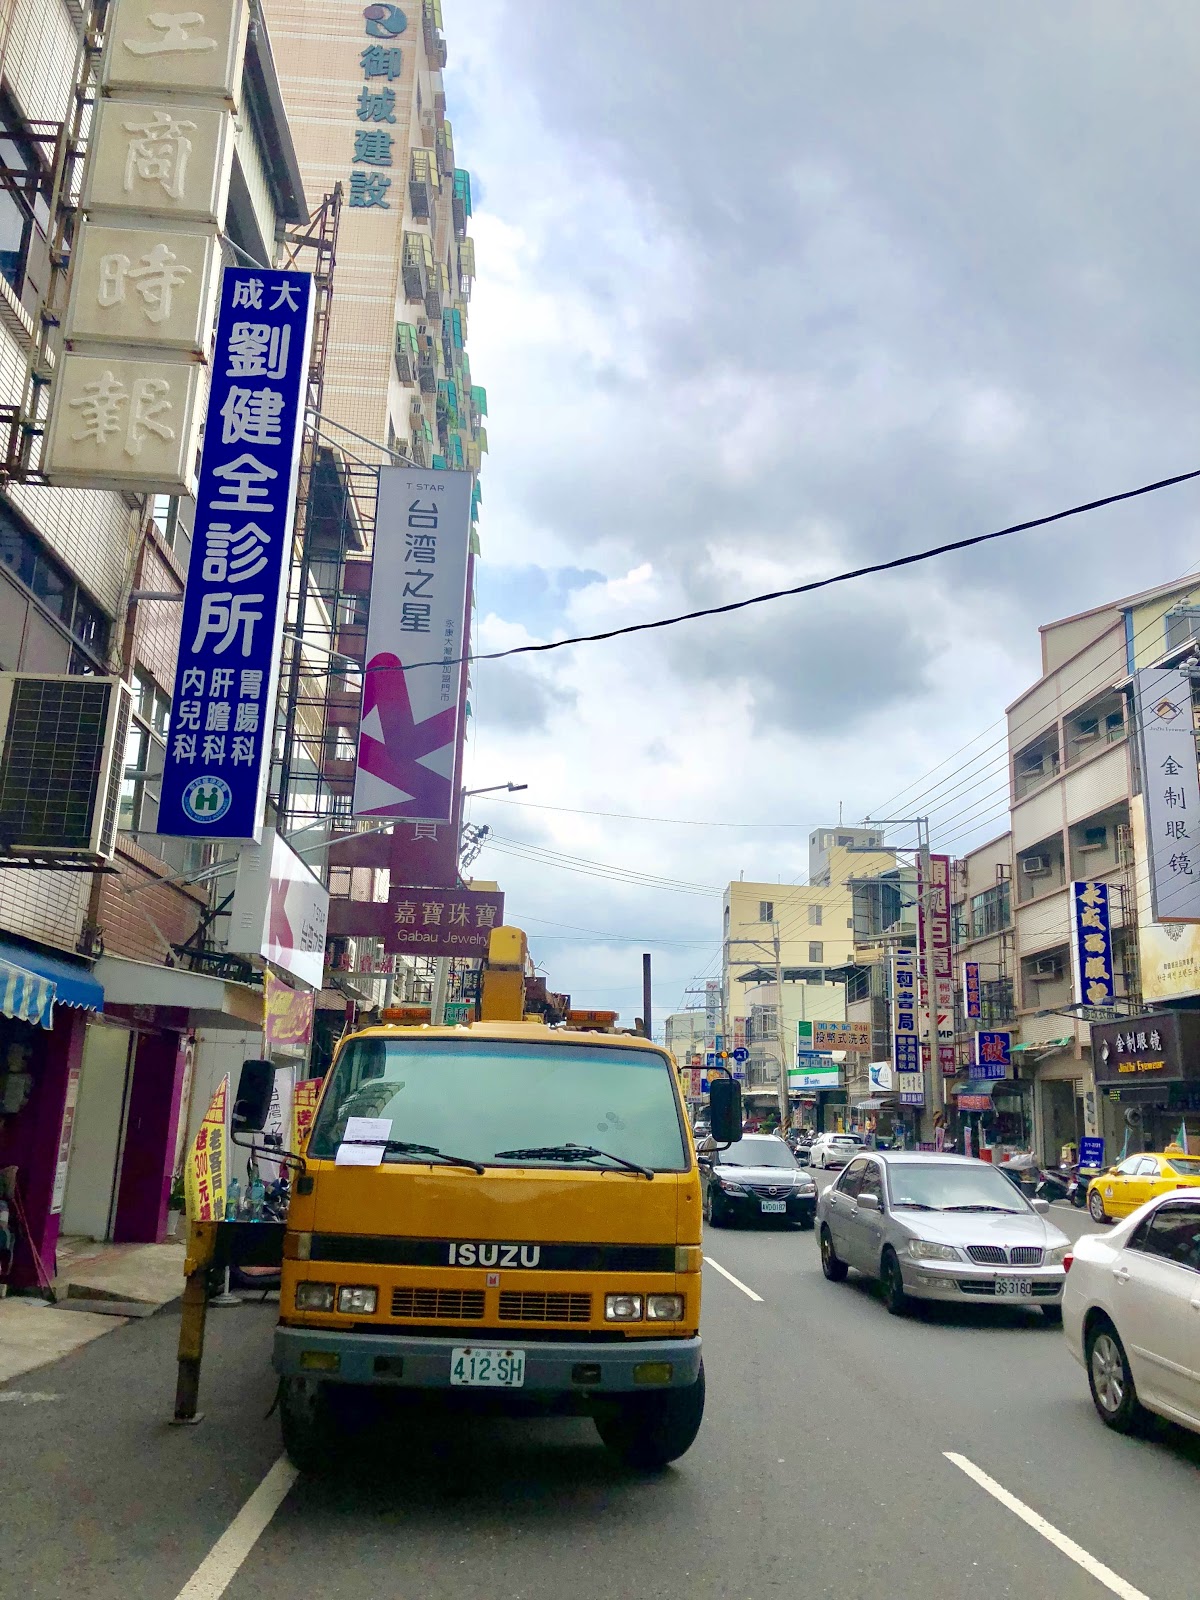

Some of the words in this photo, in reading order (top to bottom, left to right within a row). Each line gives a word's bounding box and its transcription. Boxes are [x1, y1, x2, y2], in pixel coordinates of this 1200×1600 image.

[348, 44, 403, 210] 御城建設
[69, 11, 217, 457] 工商時報
[191, 322, 291, 657] 劉健全診所
[416, 483, 445, 492] STAR
[399, 499, 439, 633] 台湾之星
[173, 666, 206, 765] 內兒科
[201, 668, 235, 766] 肝膽科
[231, 669, 263, 767] 胃腸科
[1160, 755, 1193, 876] 金制眼镜
[394, 899, 498, 928] 嘉寶珠寶
[397, 929, 438, 943] Gabau
[442, 932, 490, 949] Jewelry
[816, 1031, 868, 1045] 投幣式洗衣
[981, 1035, 1009, 1063] 被
[1115, 1029, 1162, 1053] 金制眼镜
[448, 1243, 541, 1268] ISUZU
[454, 1357, 522, 1381] 412-SH
